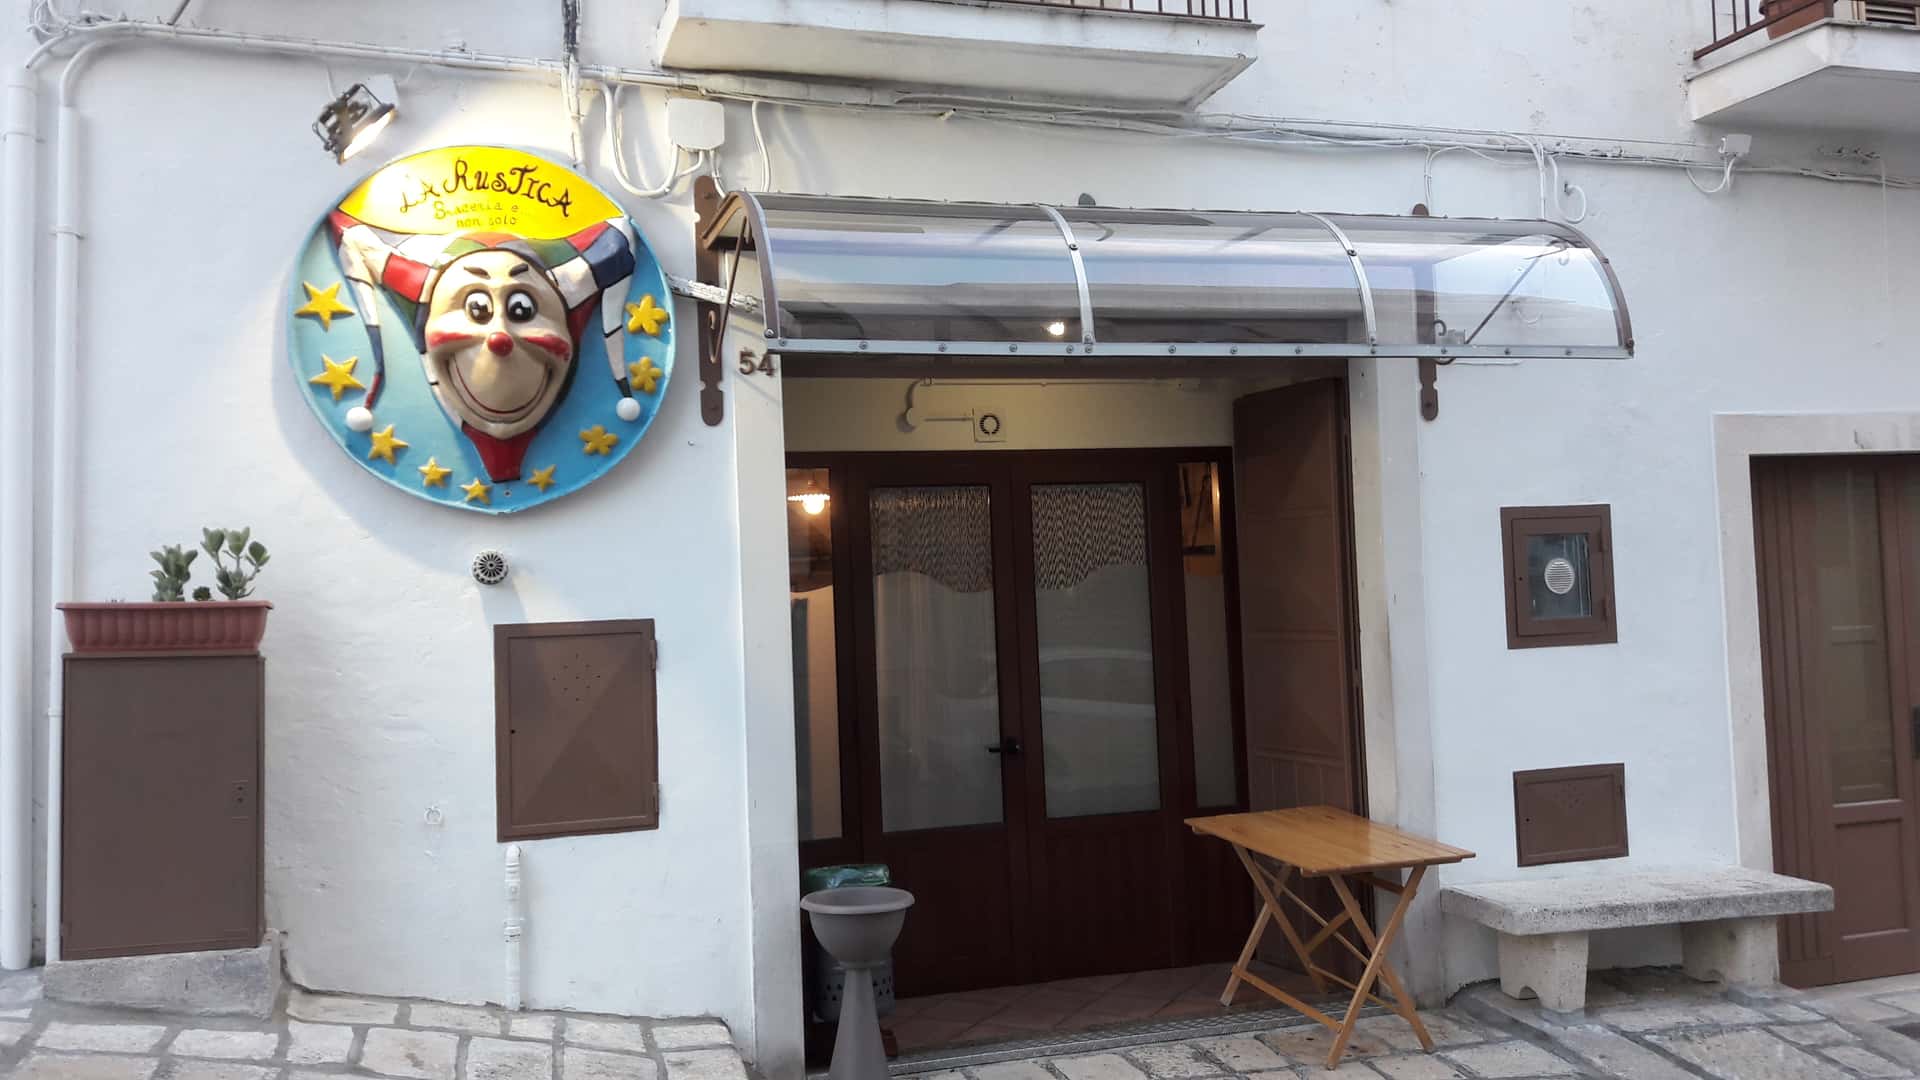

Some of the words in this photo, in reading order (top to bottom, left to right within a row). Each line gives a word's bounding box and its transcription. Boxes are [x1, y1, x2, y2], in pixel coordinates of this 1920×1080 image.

[400, 178, 440, 213] LA
[456, 218, 481, 228] non
[489, 214, 518, 226] solo
[739, 351, 775, 376] 54
